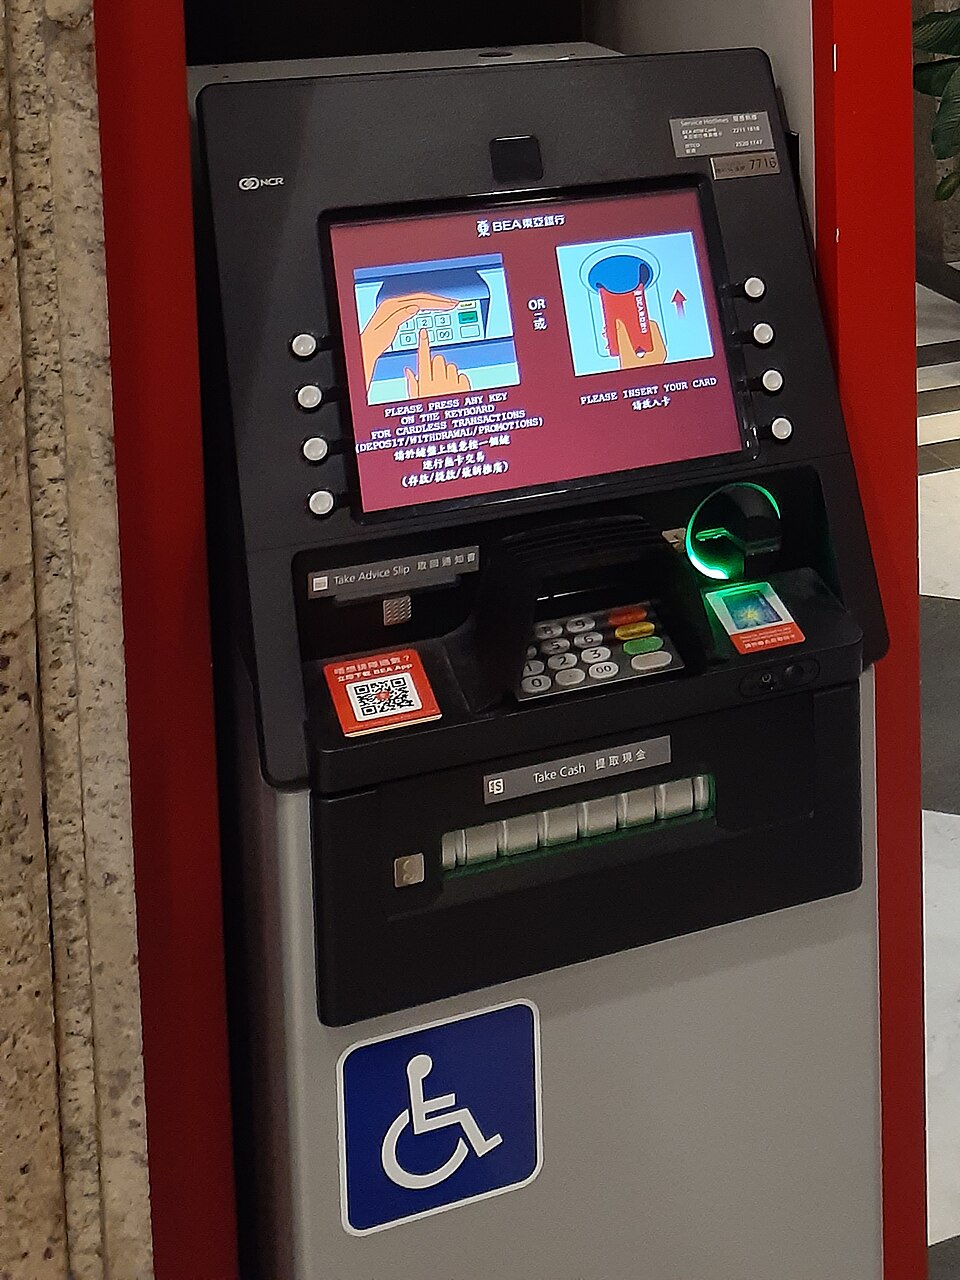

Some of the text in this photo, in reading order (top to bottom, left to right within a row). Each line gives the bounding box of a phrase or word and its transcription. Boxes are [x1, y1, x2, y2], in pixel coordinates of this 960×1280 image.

[749, 157, 777, 171] 7716
[260, 177, 285, 187] NCR
[492, 214, 565, 232] BEA 東亞銀行
[527, 298, 546, 310] OR
[580, 377, 717, 406] PLEASE INSERT YOUR CARD
[384, 392, 508, 418] PLEASE PRESS ANY KEY
[400, 404, 495, 425] ON THE KEYBOARD
[371, 409, 526, 440] FOR CARDLESS TRANSACTIONS
[334, 574, 356, 586] Take
[357, 568, 390, 582] Advice
[392, 564, 411, 577] Slip
[551, 635, 594, 650] 5 6
[557, 656, 567, 666] 2
[590, 649, 601, 659] 3
[373, 666, 393, 675] BEA
[394, 663, 413, 672] App
[531, 665, 612, 688] 0 00
[533, 748, 647, 784] Take Cash 提取現金
